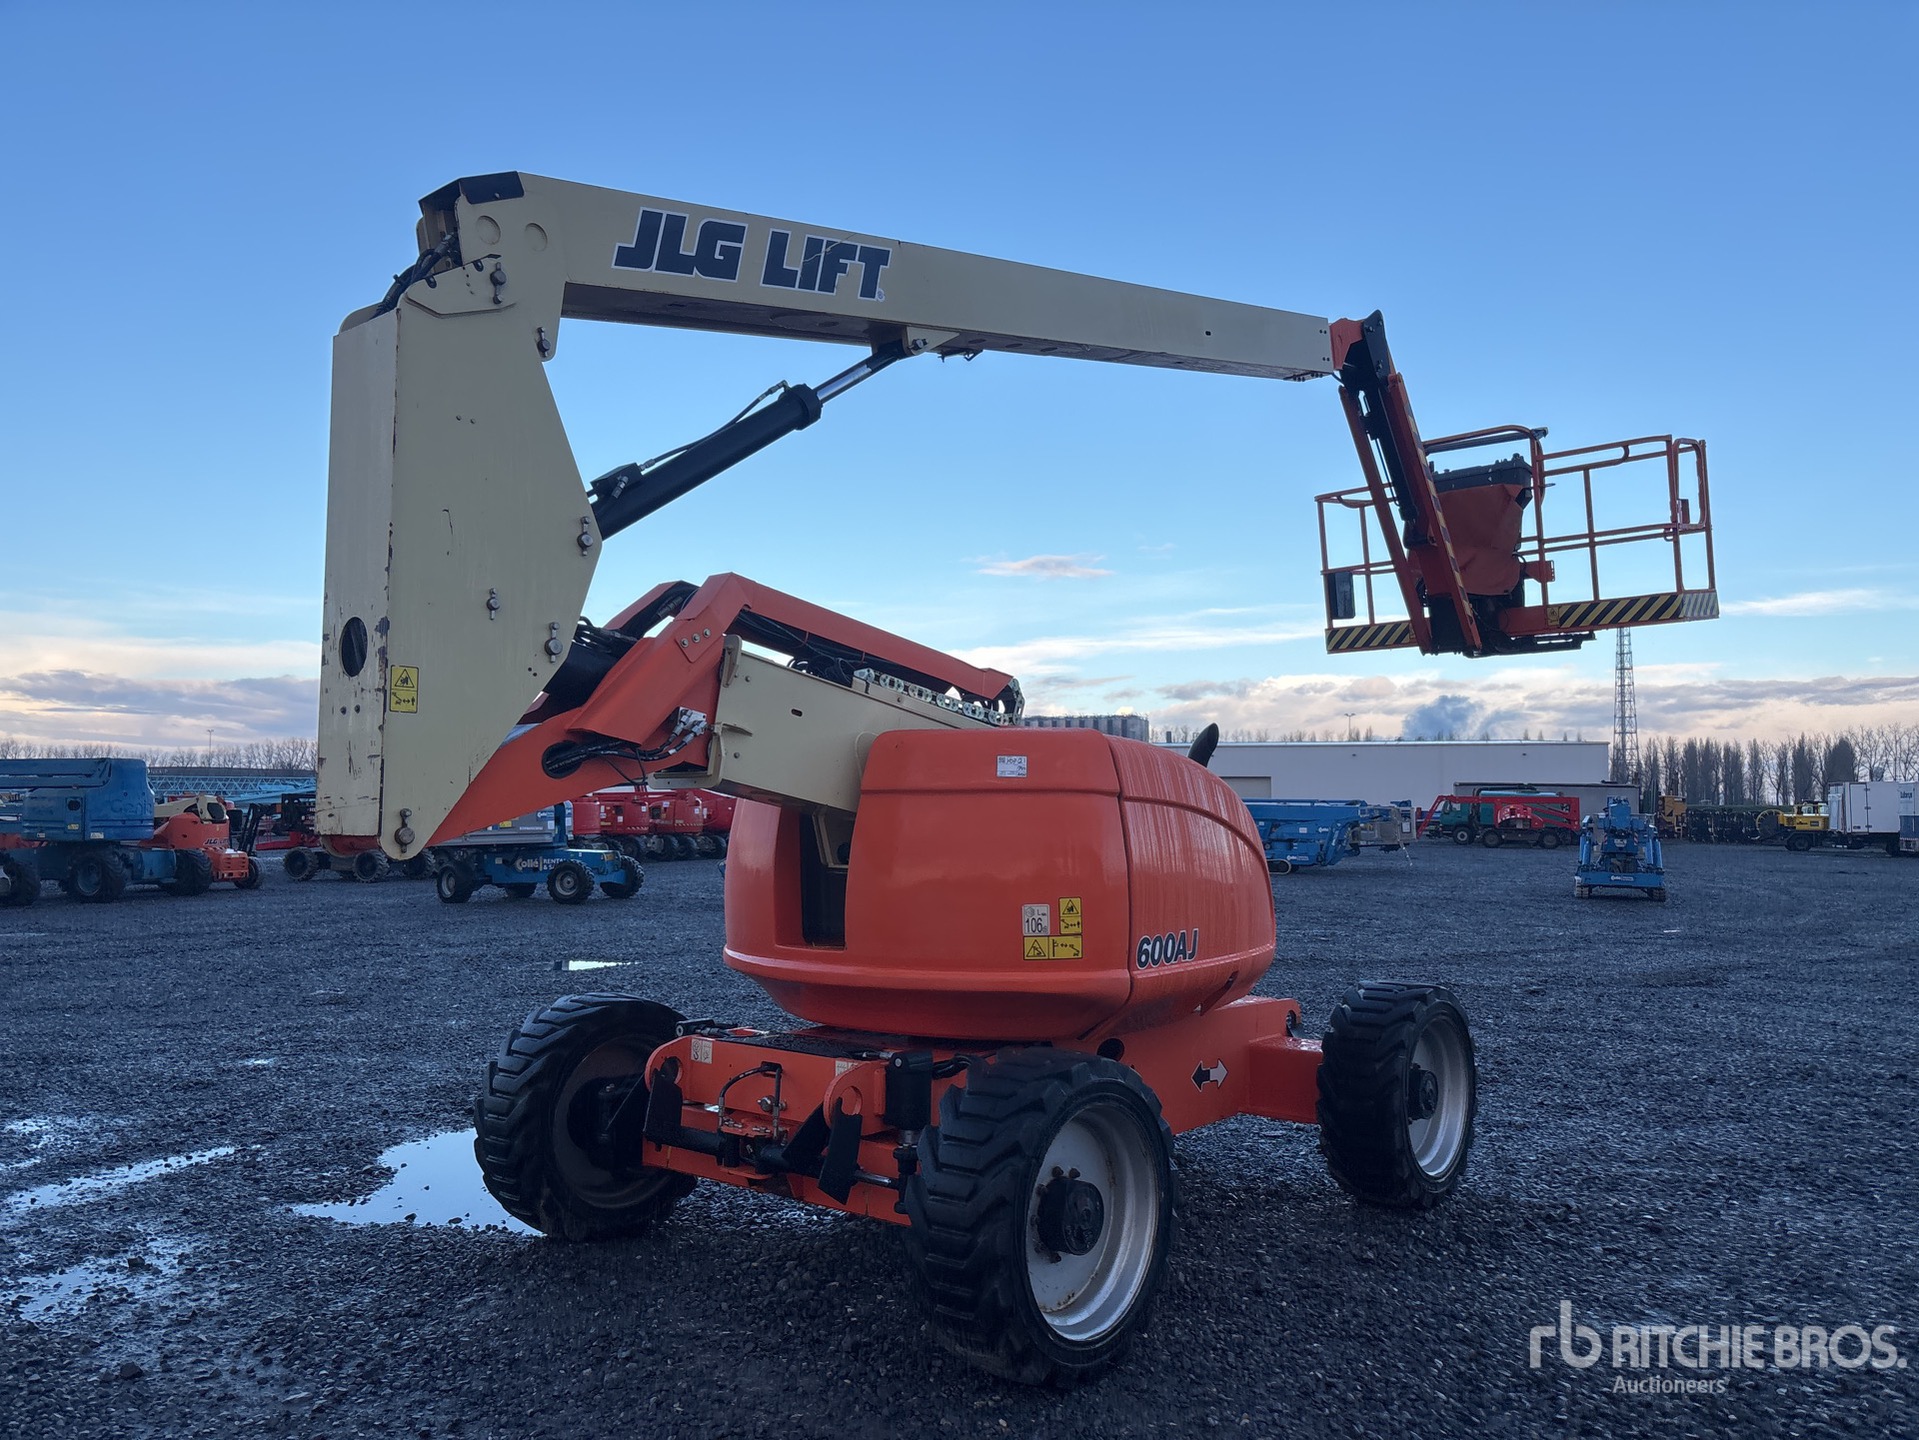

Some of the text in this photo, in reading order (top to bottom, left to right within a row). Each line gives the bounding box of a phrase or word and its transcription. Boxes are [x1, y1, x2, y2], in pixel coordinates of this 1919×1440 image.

[611, 207, 892, 302] JLG LIFT
[1025, 917, 1043, 933] 106
[1136, 928, 1199, 970] 600AJ
